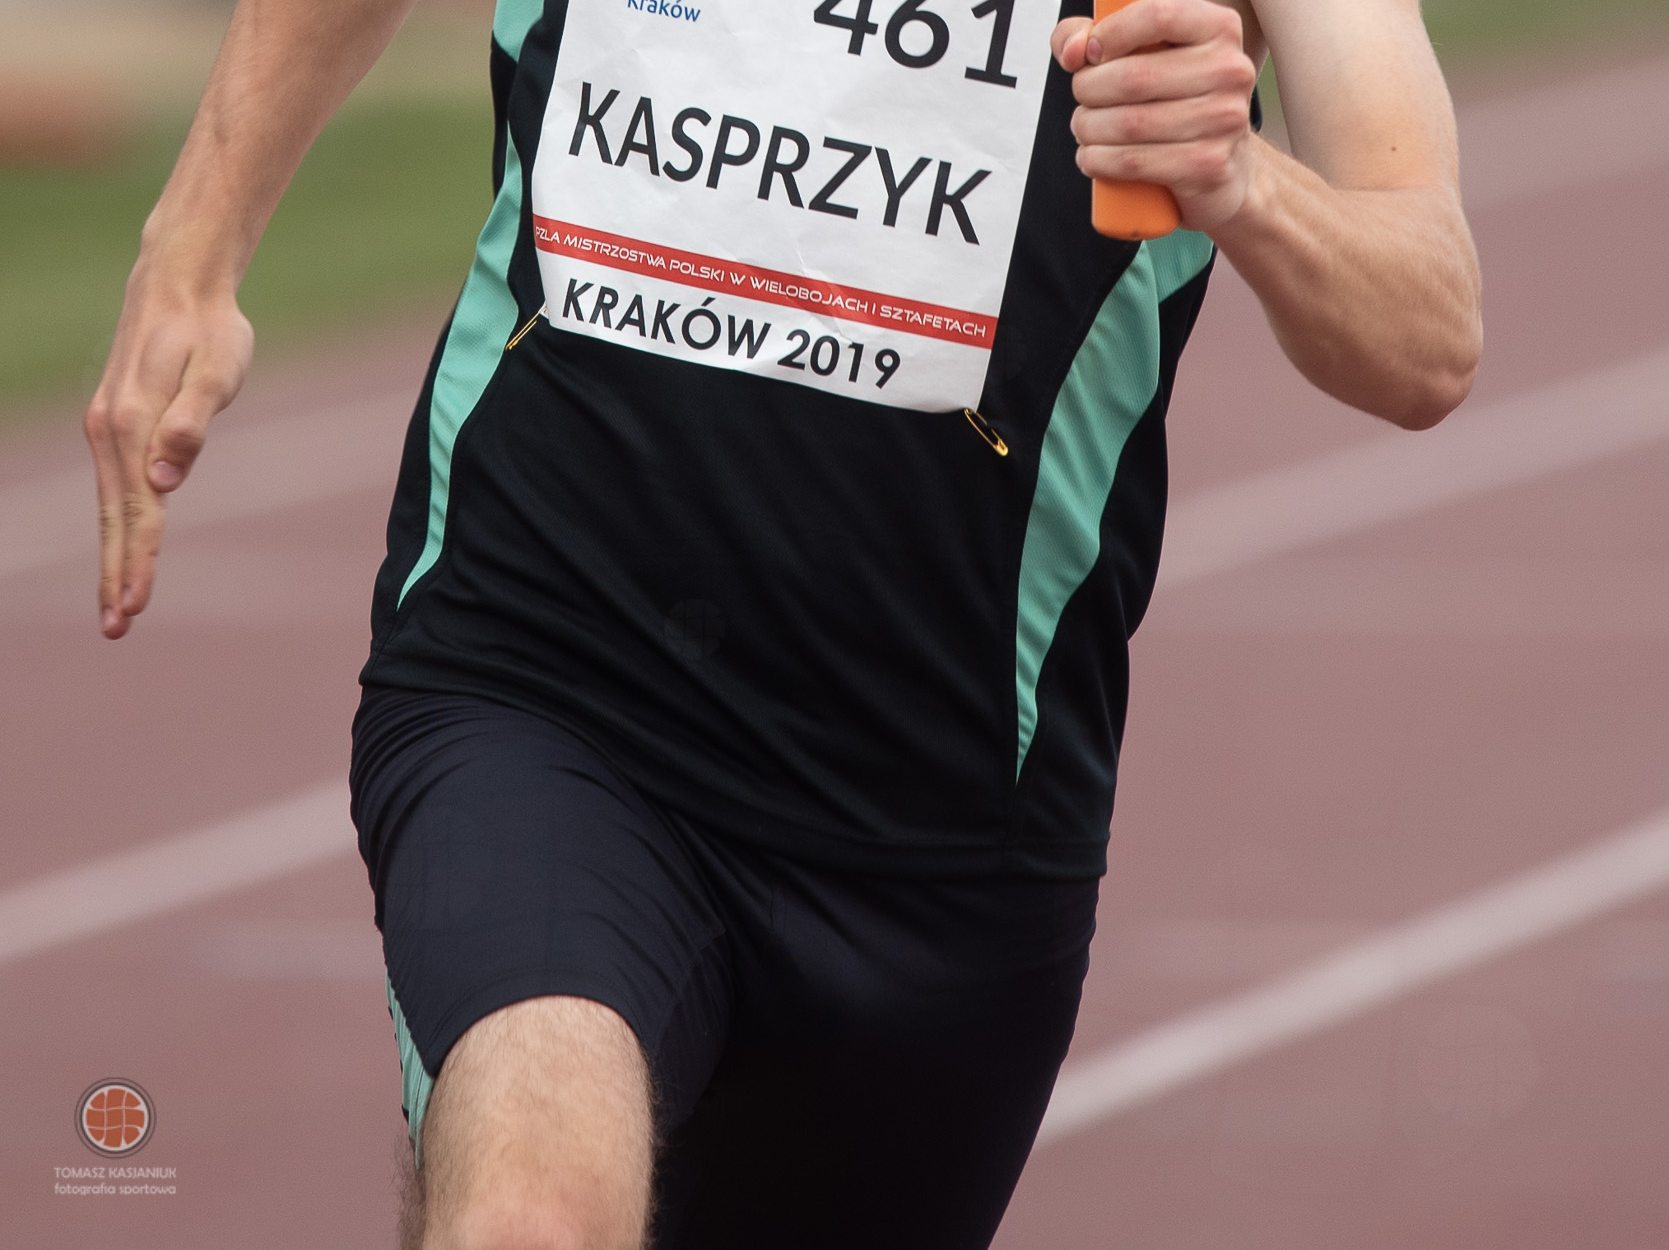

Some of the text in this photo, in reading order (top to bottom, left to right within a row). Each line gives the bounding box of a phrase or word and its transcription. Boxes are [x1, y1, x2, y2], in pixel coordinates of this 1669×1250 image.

[568, 82, 993, 246] KASPRZYK
[535, 226, 560, 244] PZLA
[563, 234, 666, 269] MISTRZOSTWA
[669, 259, 725, 282] POLSKI
[729, 272, 746, 286] W
[749, 276, 868, 314] WIELOBOJACH
[879, 306, 986, 338] SZTAFETACH
[562, 277, 901, 390] KRAKÓW 2019
